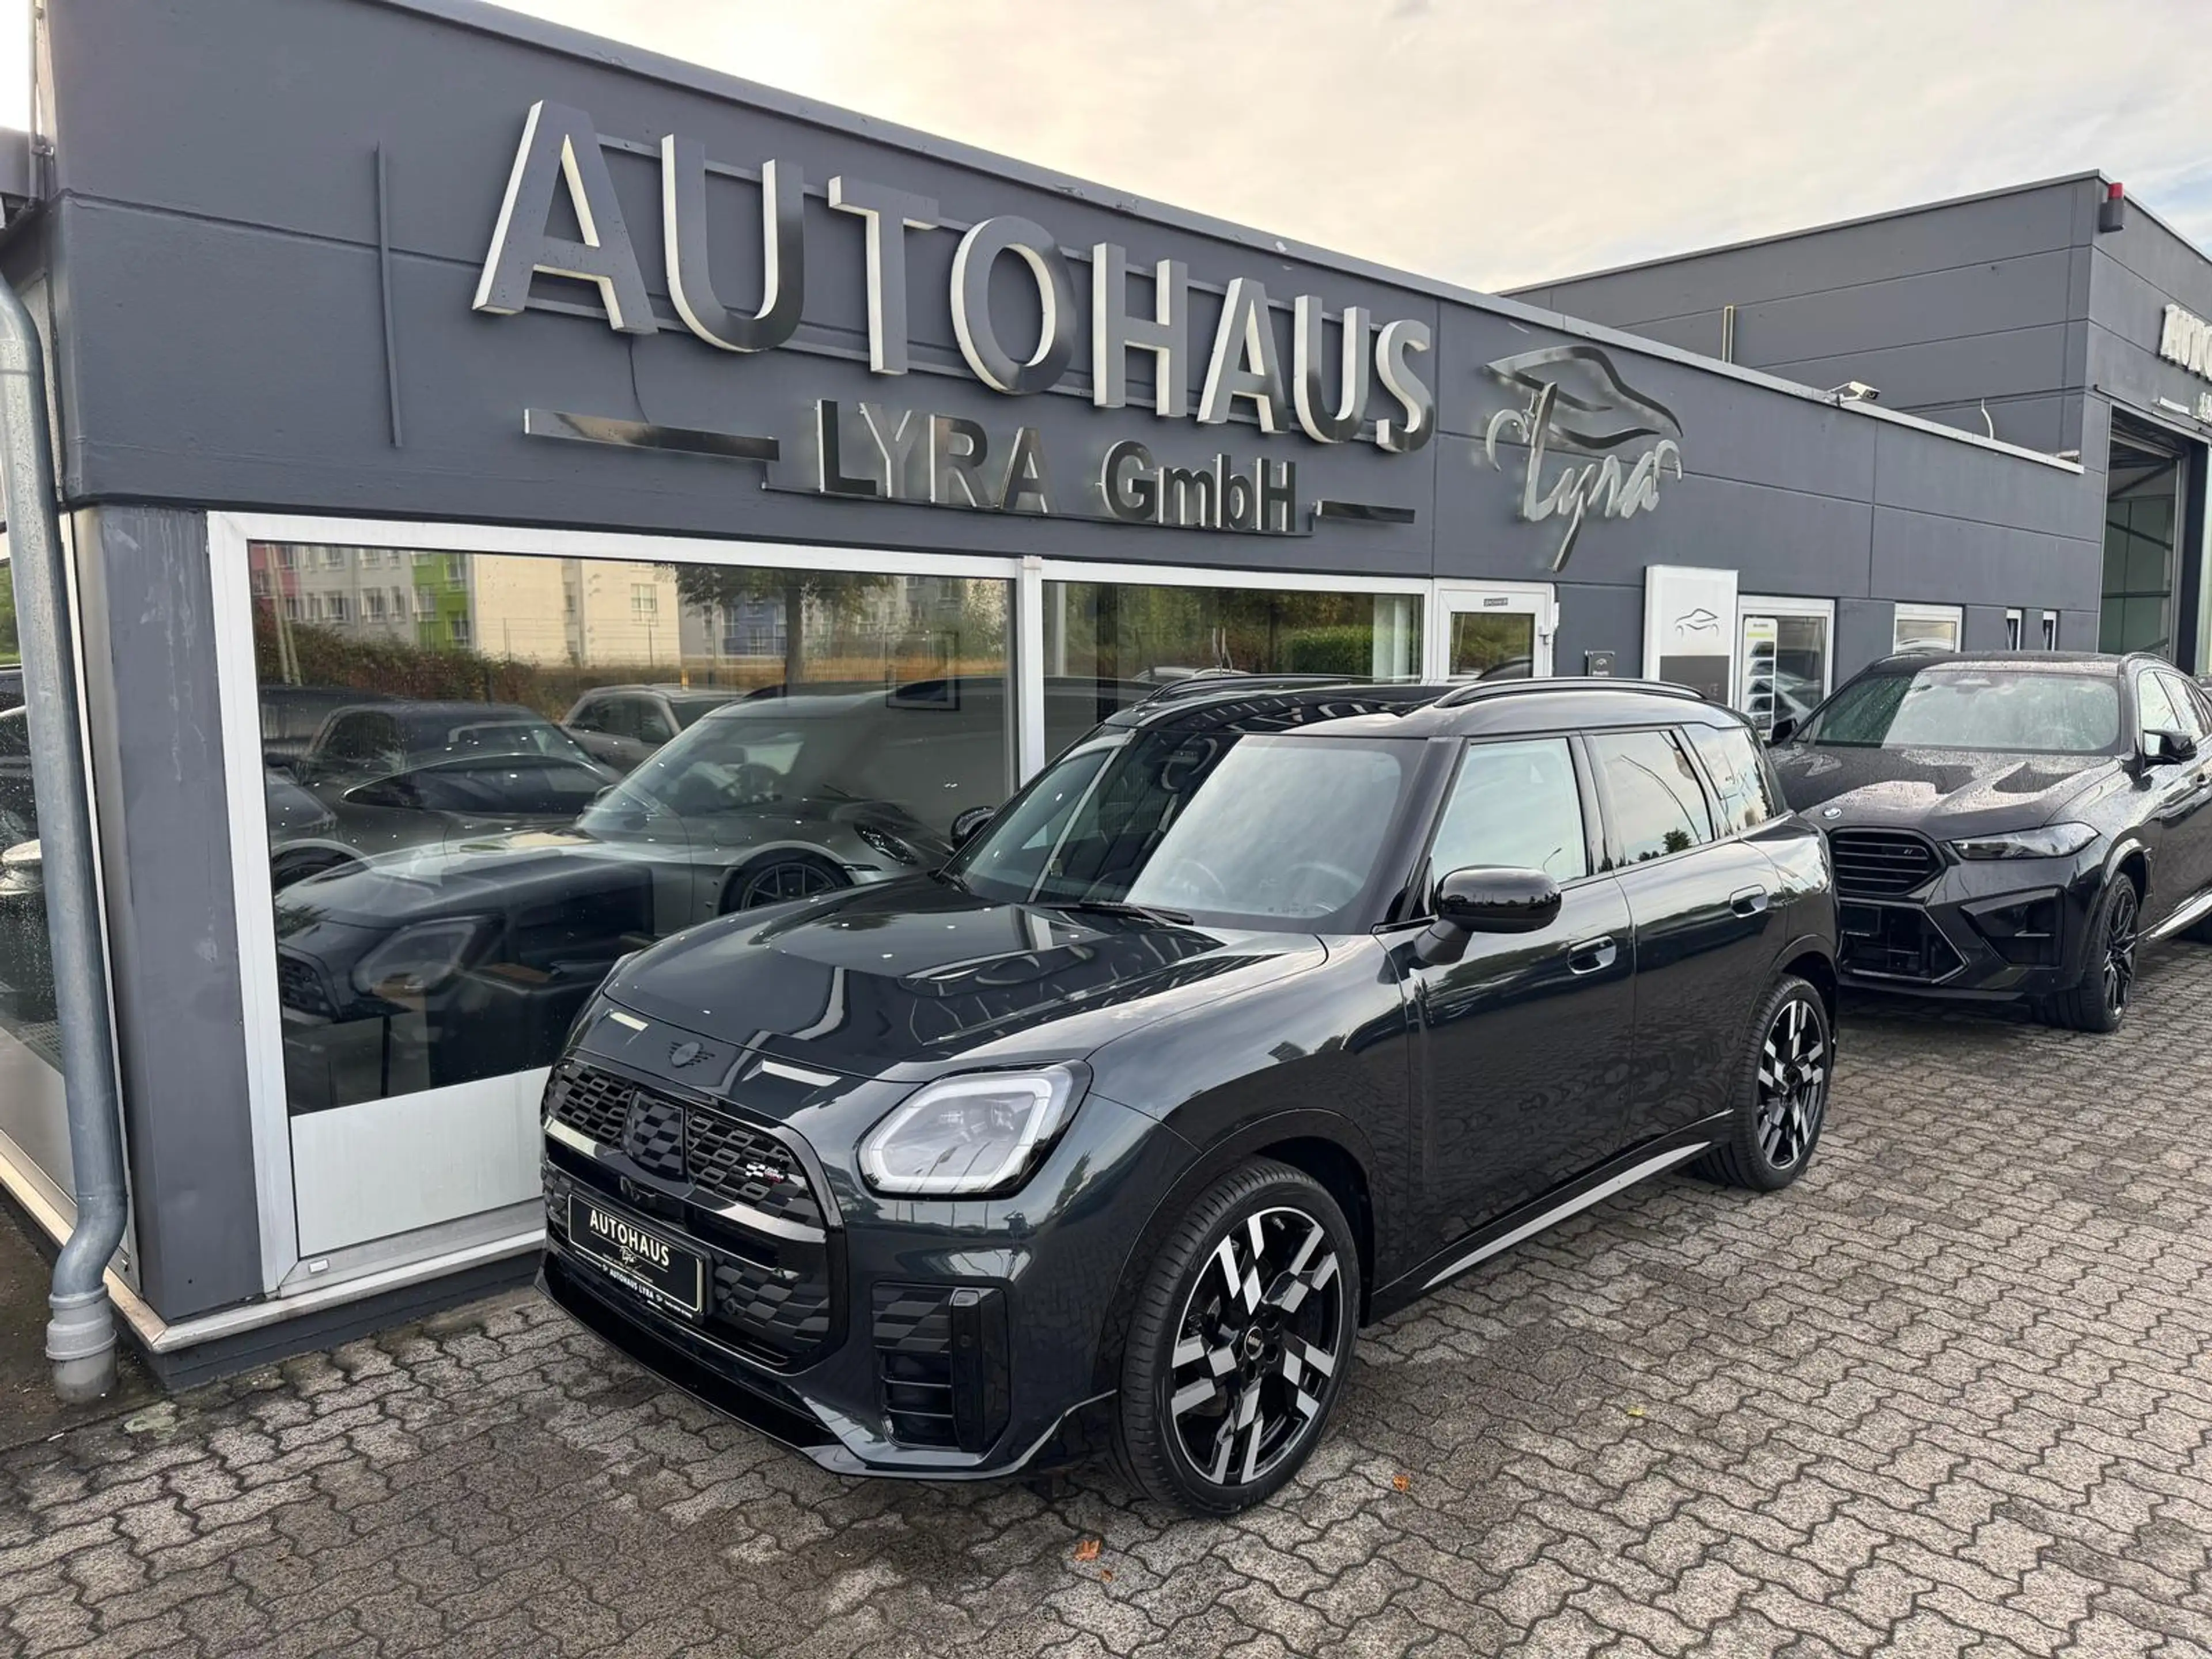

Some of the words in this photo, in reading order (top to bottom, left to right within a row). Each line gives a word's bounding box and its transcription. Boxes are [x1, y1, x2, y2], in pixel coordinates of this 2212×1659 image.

[471, 99, 1434, 453] AUTOHAUS
[816, 399, 1058, 514] LYRA
[1100, 439, 1296, 532] GmbH
[590, 1210, 670, 1266] AUTOHAUS
